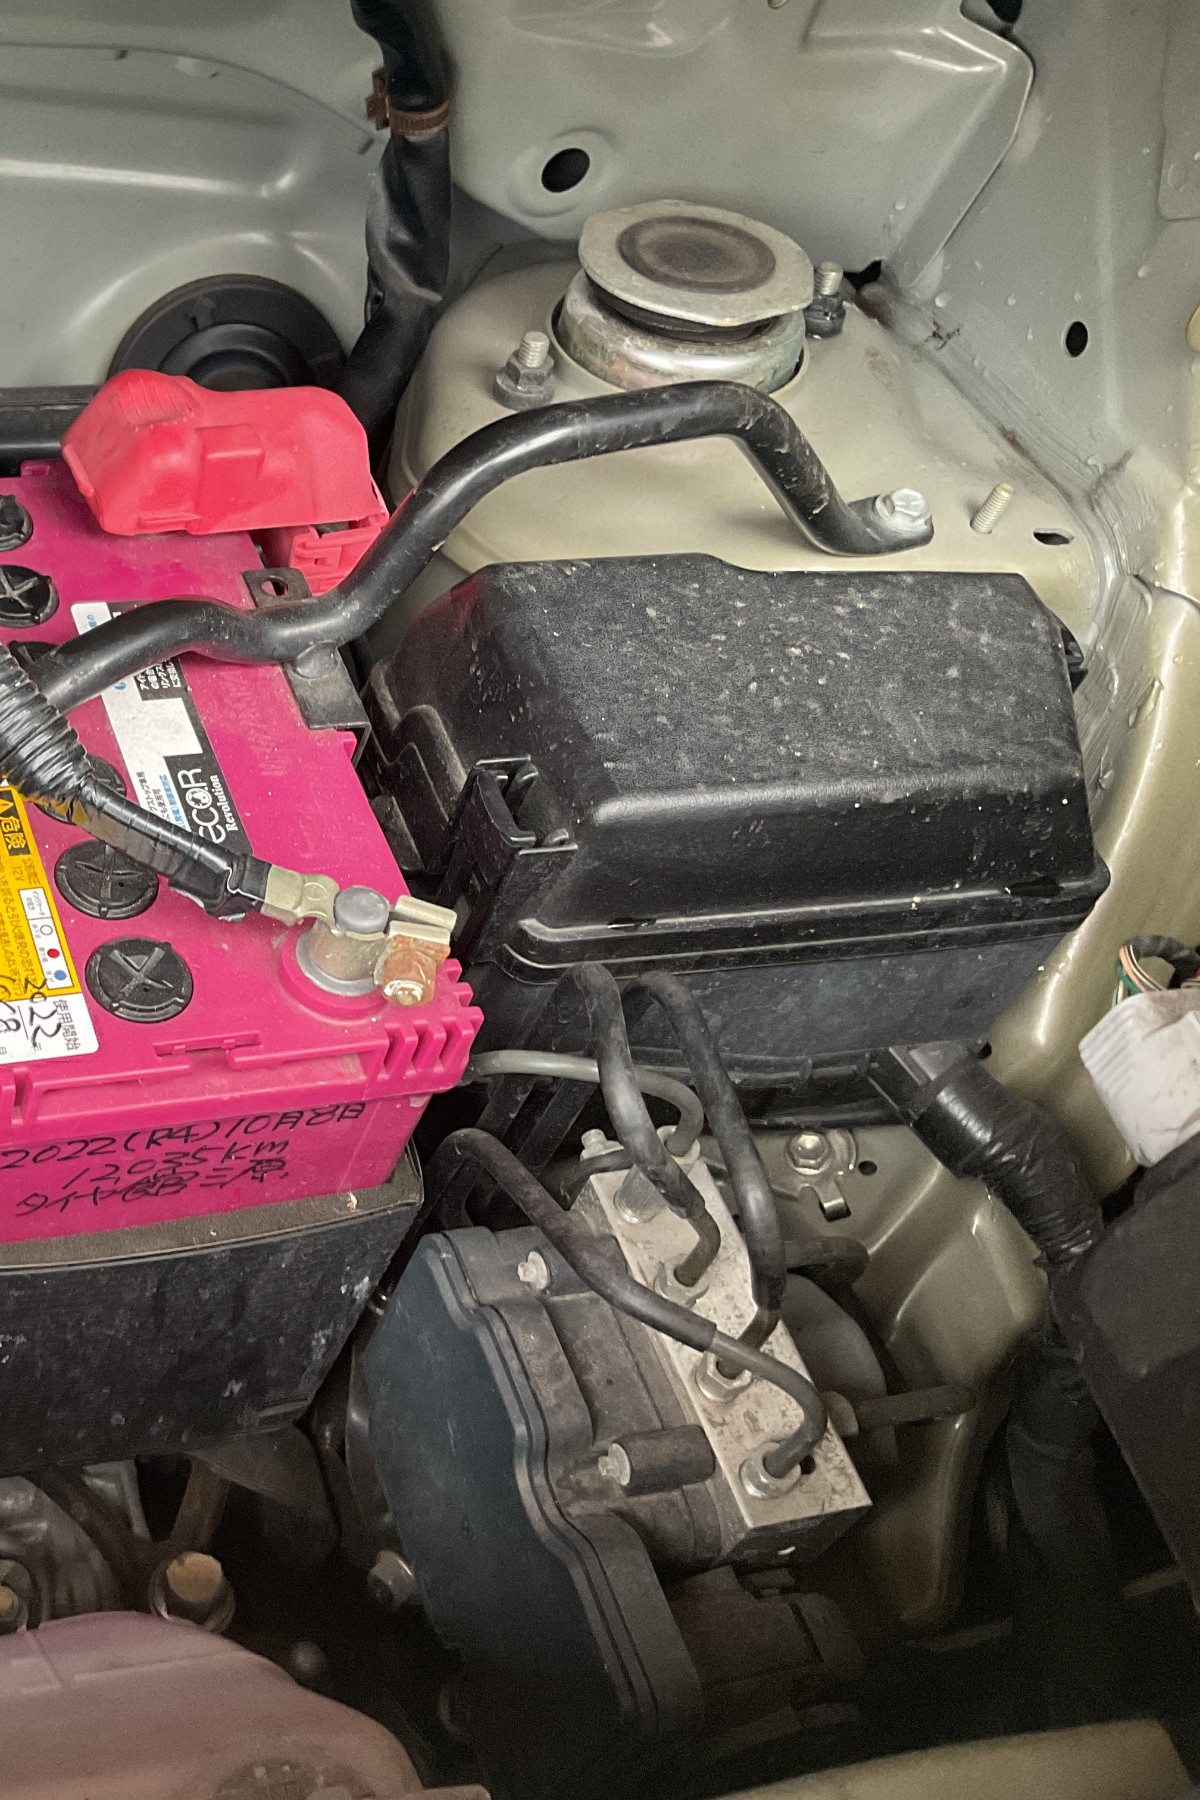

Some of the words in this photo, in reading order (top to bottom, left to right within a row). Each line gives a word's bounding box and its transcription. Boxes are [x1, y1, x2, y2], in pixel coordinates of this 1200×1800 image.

[209, 775, 238, 832] Revolution
[0, 817, 27, 849] 危険
[53, 999, 82, 1051] 使用開始
